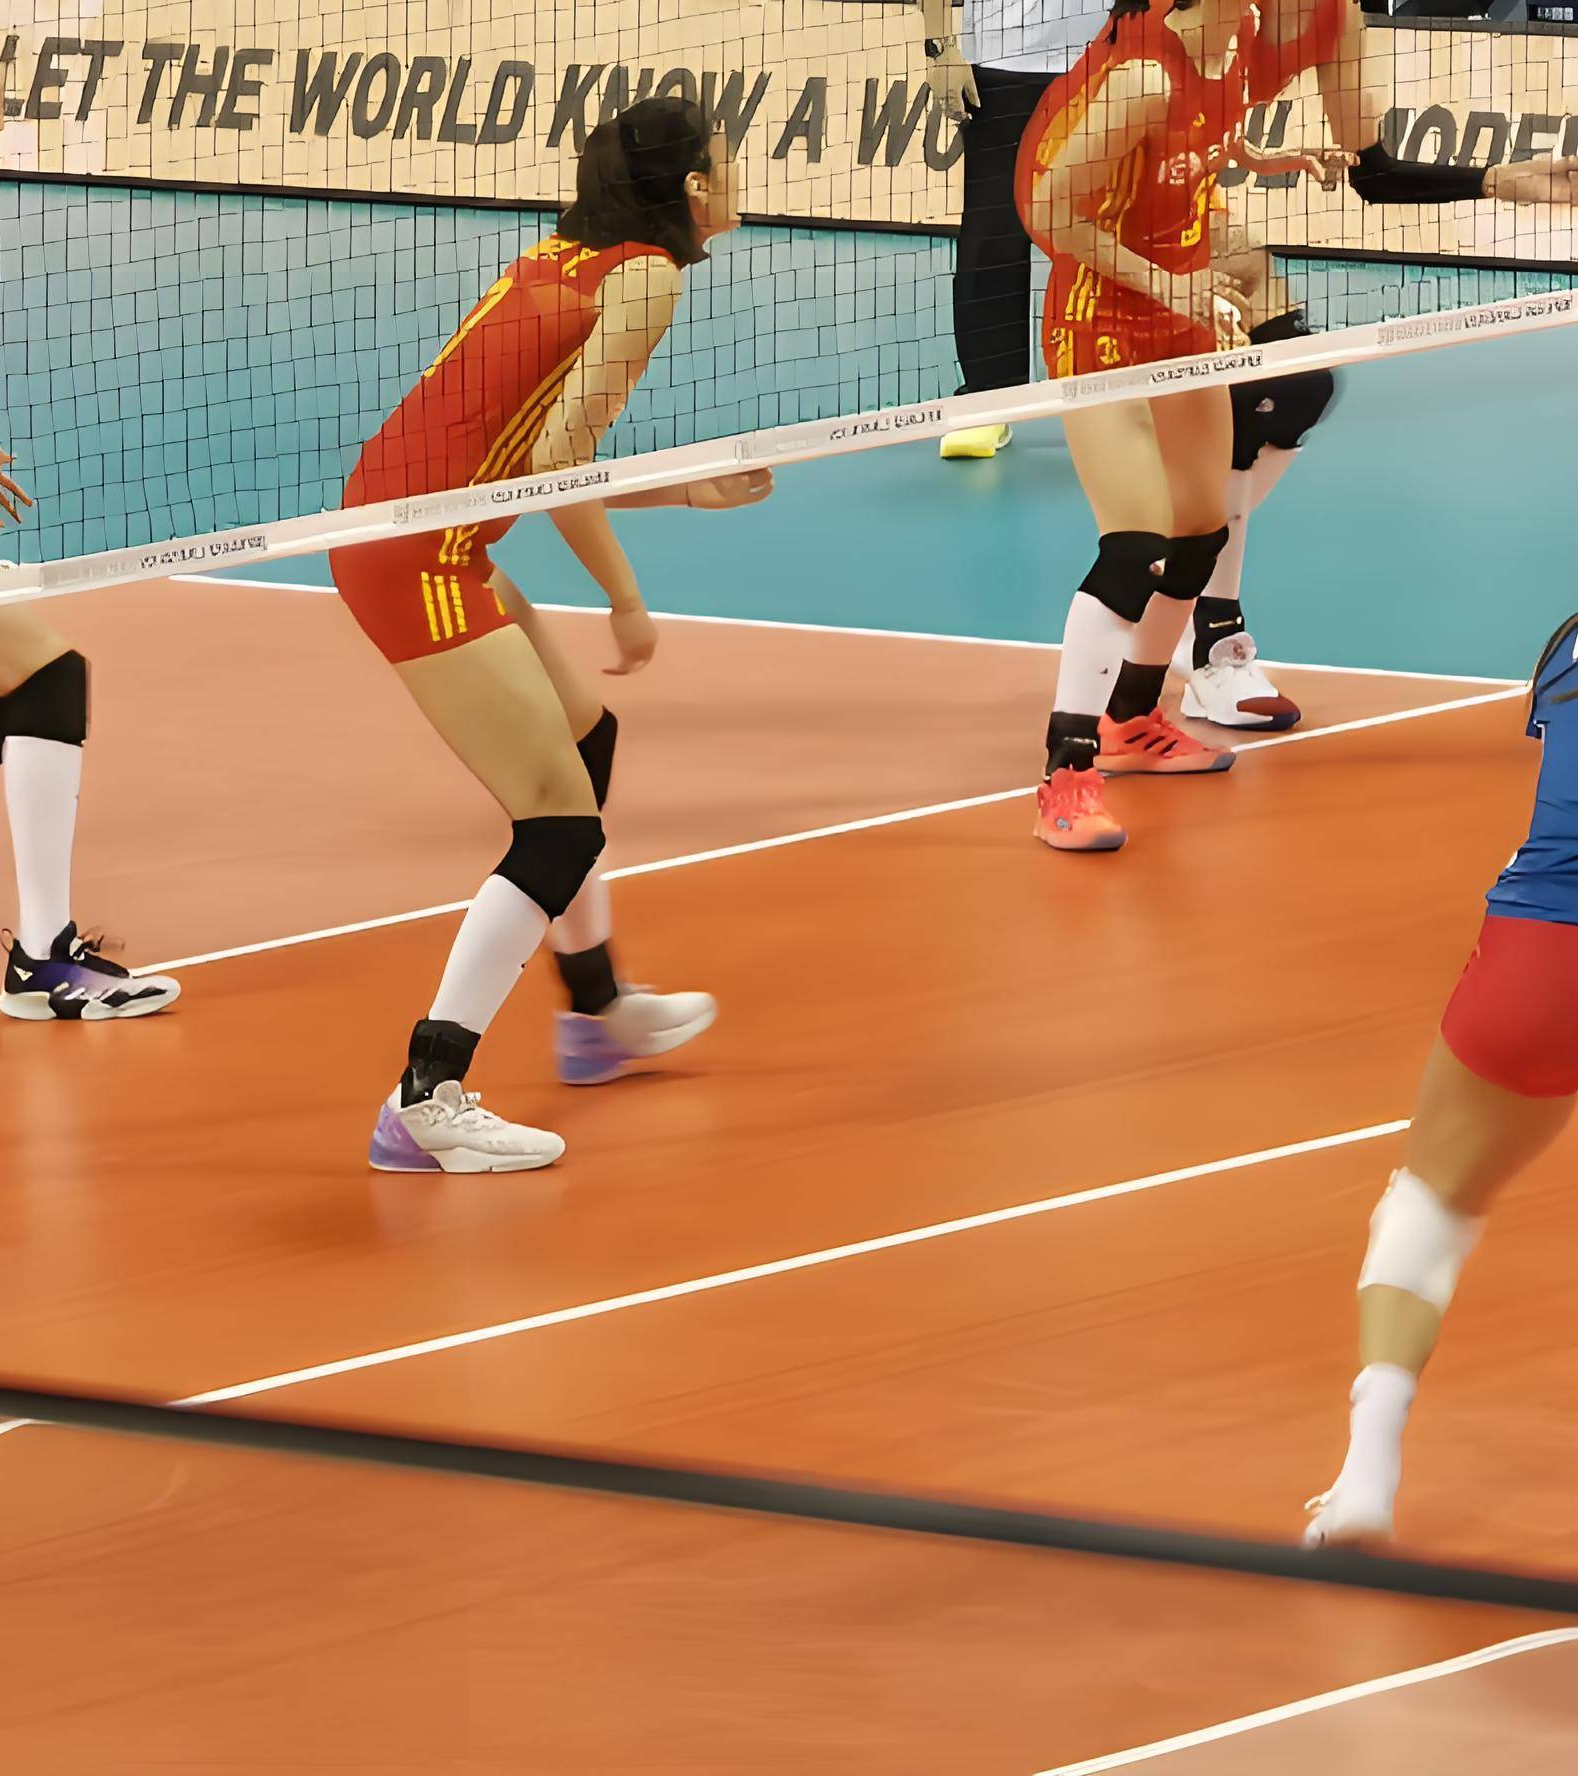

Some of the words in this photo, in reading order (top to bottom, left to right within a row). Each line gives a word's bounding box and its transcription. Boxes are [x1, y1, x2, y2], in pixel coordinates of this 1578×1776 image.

[136, 42, 274, 131] THE
[289, 49, 536, 147] WORLD
[771, 76, 828, 165] A
